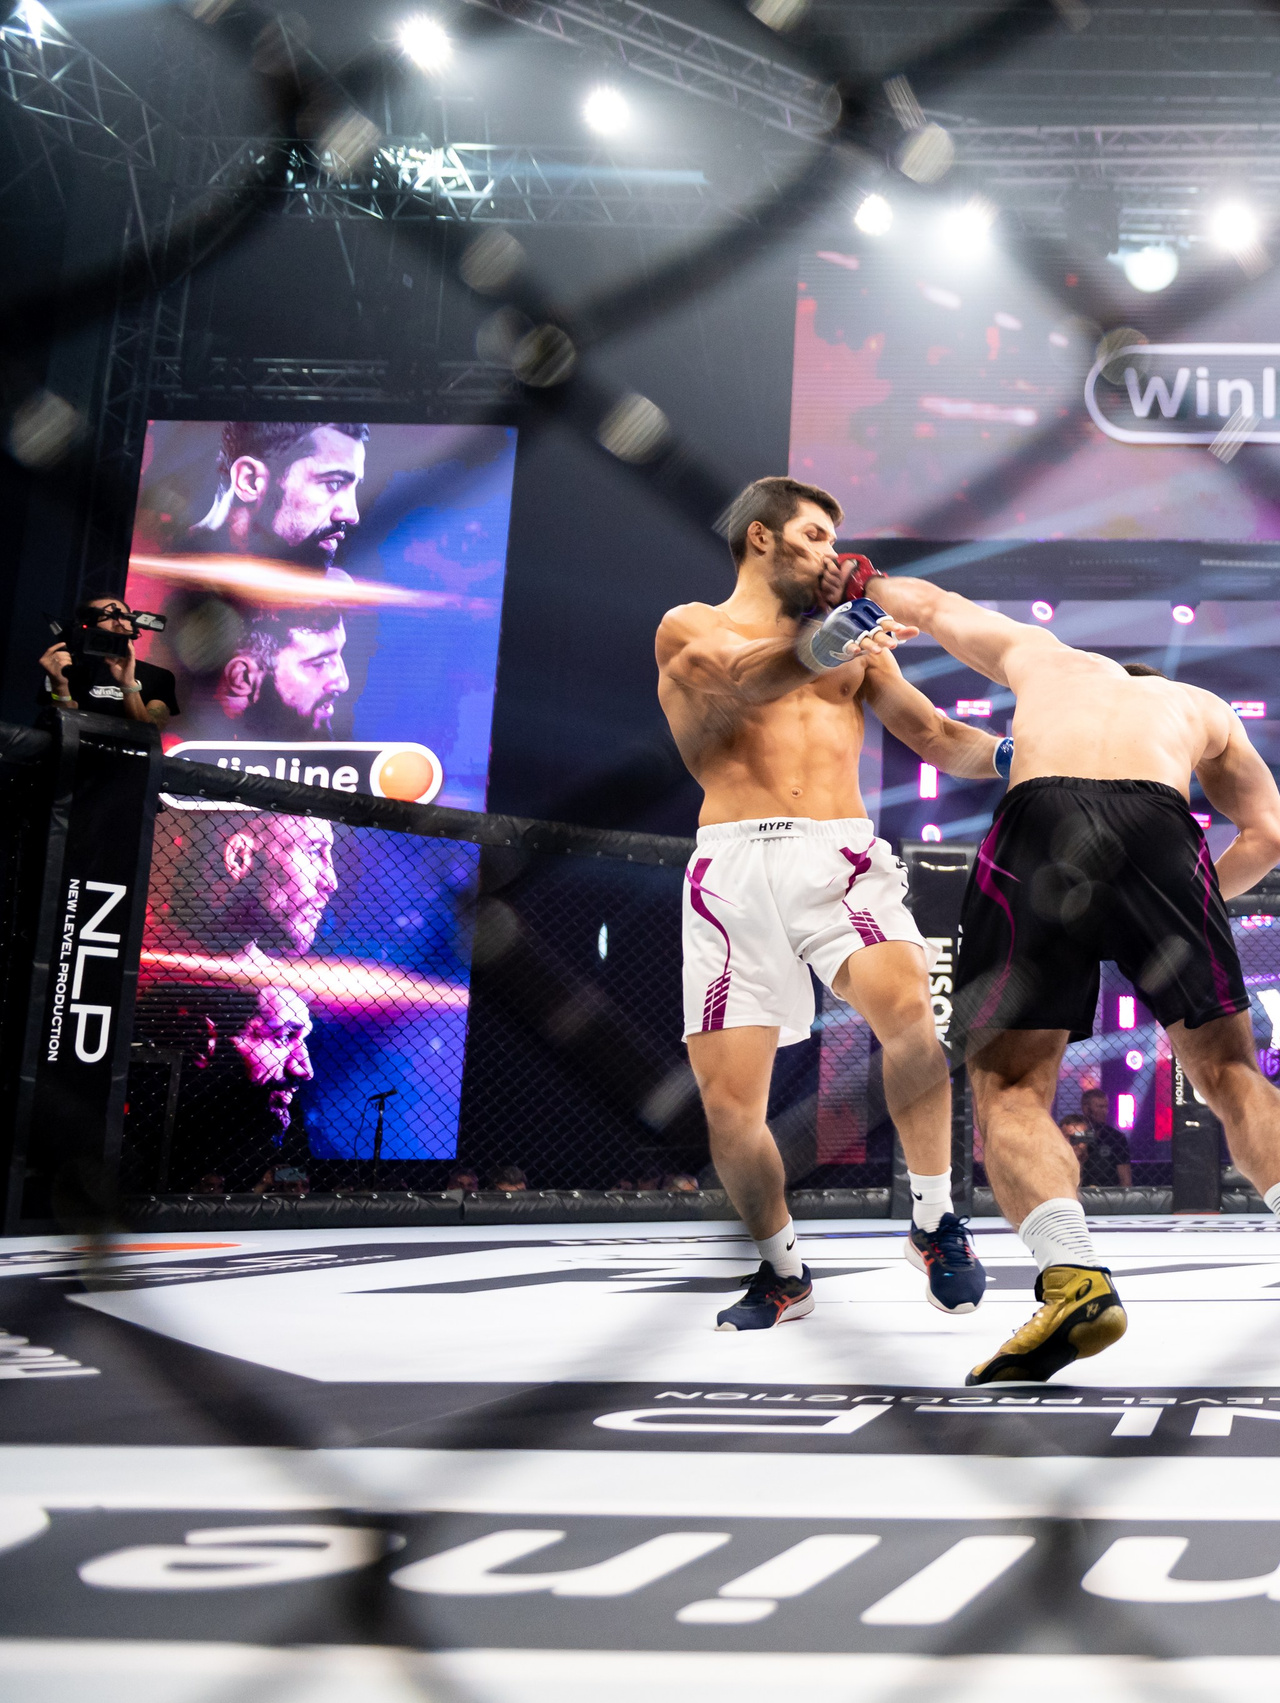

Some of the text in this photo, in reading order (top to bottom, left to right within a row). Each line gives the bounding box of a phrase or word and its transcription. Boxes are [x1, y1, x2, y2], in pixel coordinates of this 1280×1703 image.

[758, 821, 794, 832] HYPE
[47, 879, 80, 1061] NEW LEVEL PRODUCTION
[70, 881, 127, 1063] NLP
[653, 1391, 1084, 1405] PRODUCTION
